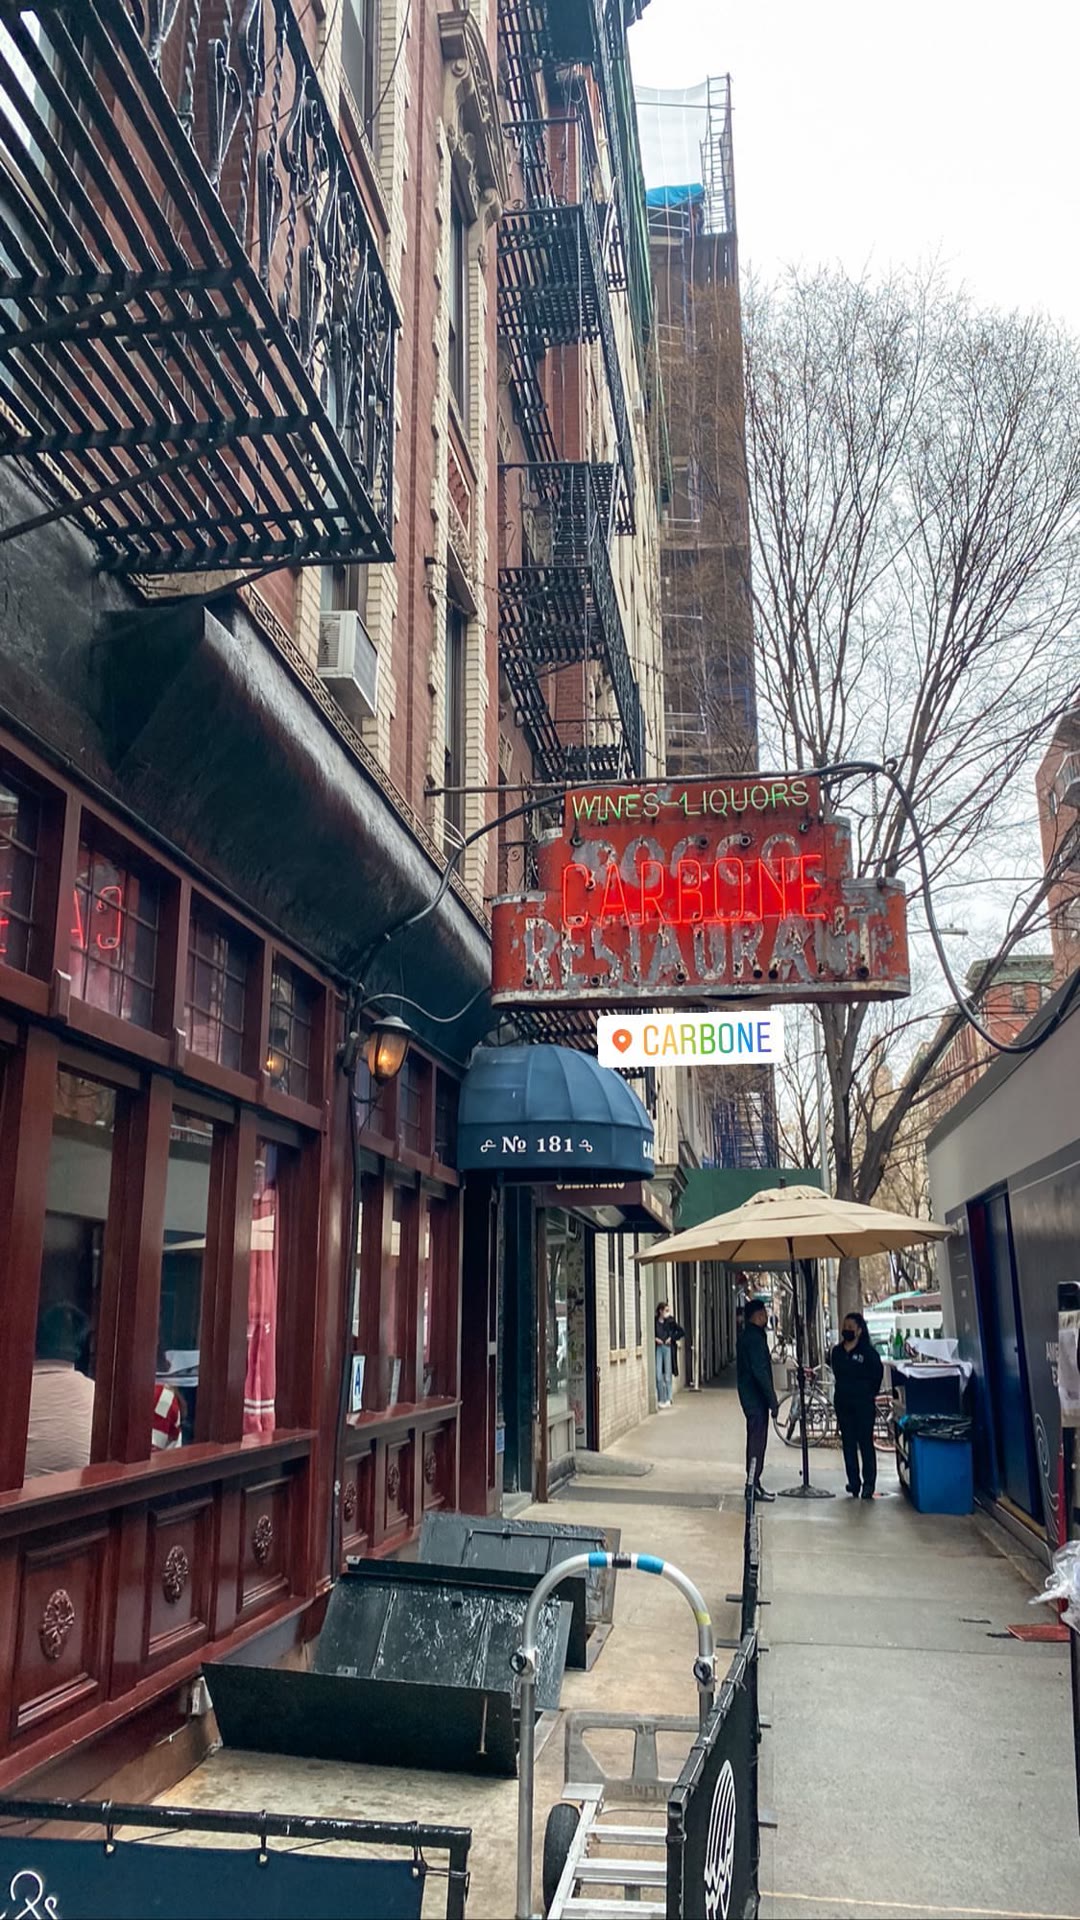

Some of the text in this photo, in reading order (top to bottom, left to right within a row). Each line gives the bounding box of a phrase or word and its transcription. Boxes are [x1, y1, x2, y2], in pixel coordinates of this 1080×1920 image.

[561, 853, 828, 929] CARBONE
[536, 1135, 574, 1153] 181
[354, 1363, 362, 1396] A
